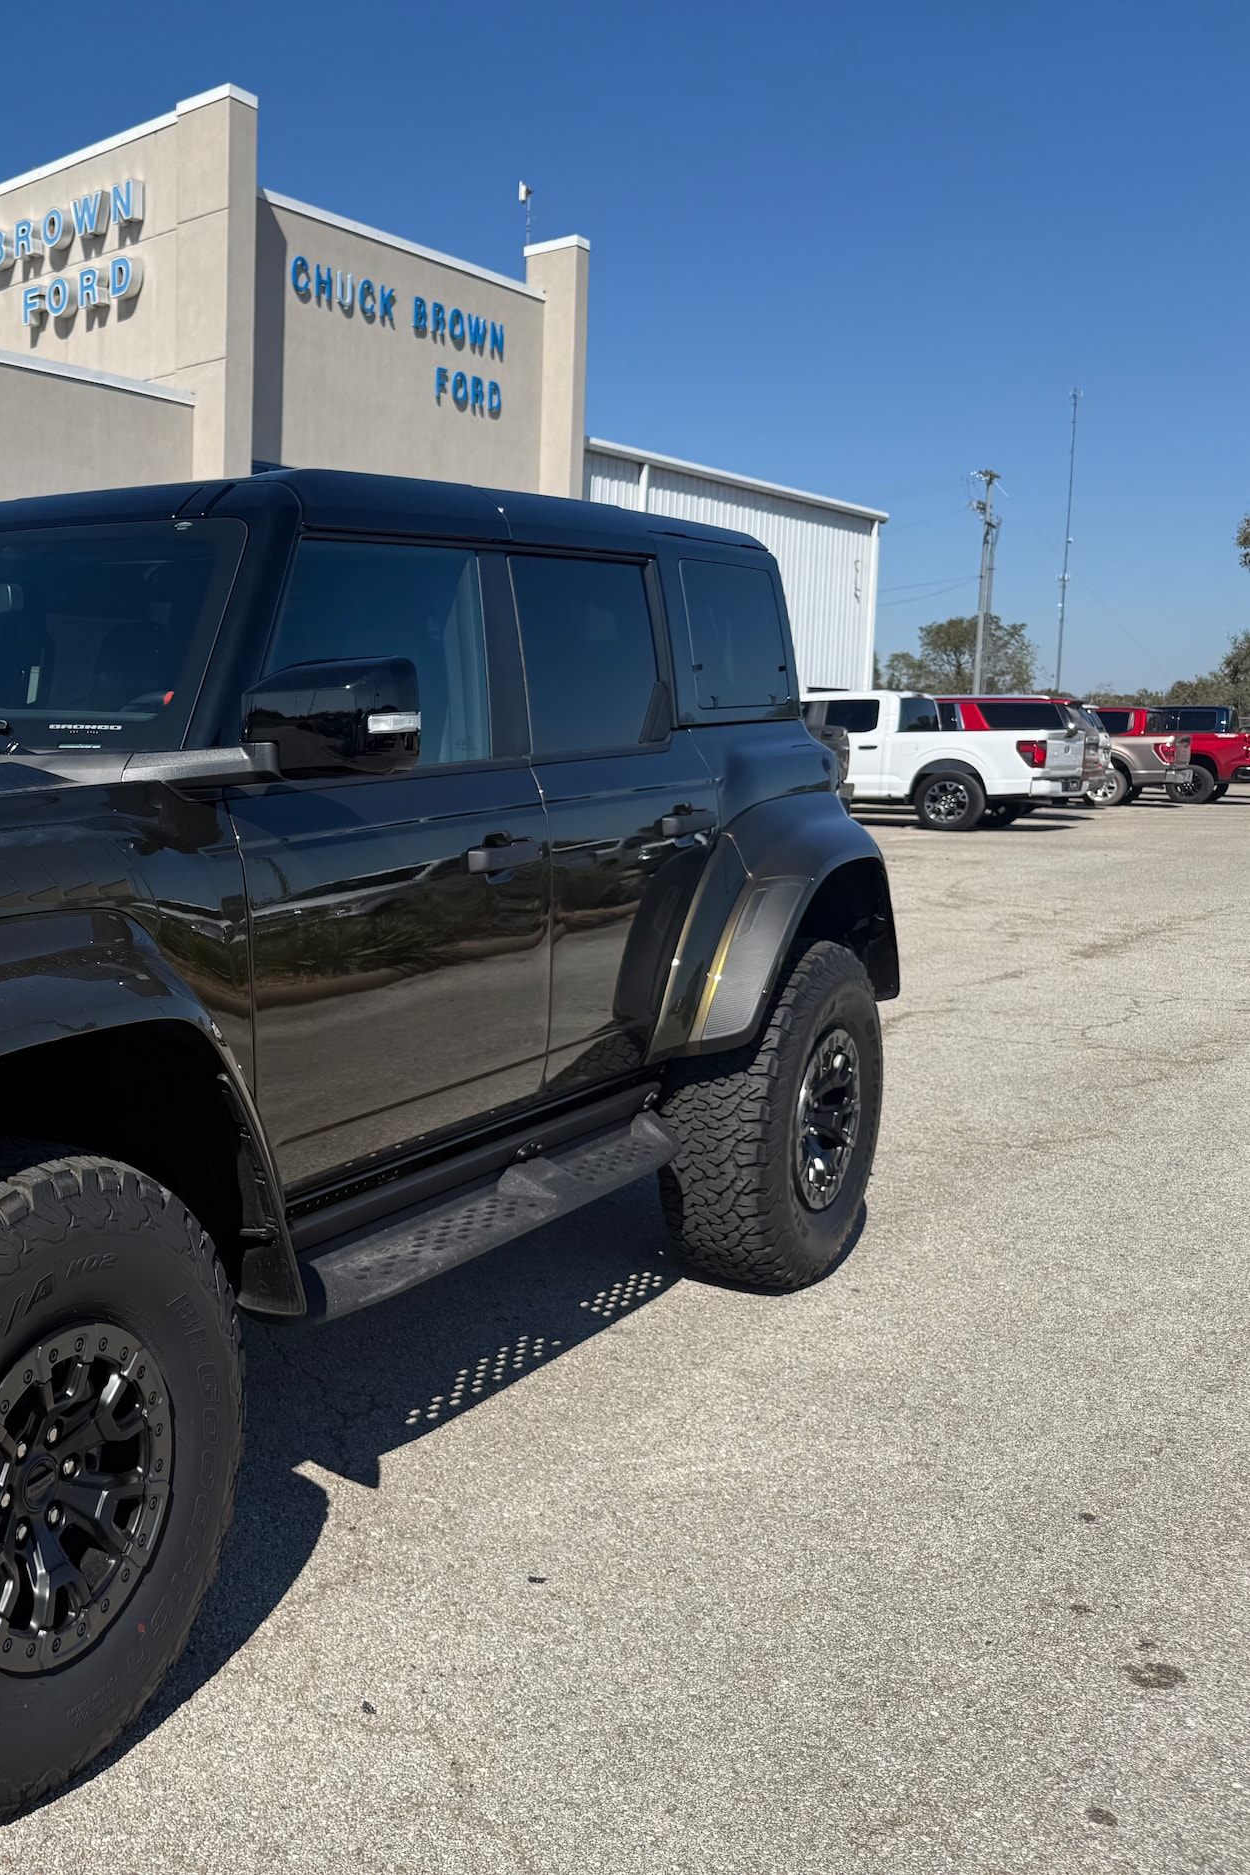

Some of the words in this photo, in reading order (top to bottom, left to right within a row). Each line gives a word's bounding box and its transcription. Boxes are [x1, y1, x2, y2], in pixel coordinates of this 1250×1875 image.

[21, 256, 141, 326] FORD
[291, 256, 396, 321] CHUCK
[412, 296, 505, 354] BROWN
[434, 366, 502, 412] FORD
